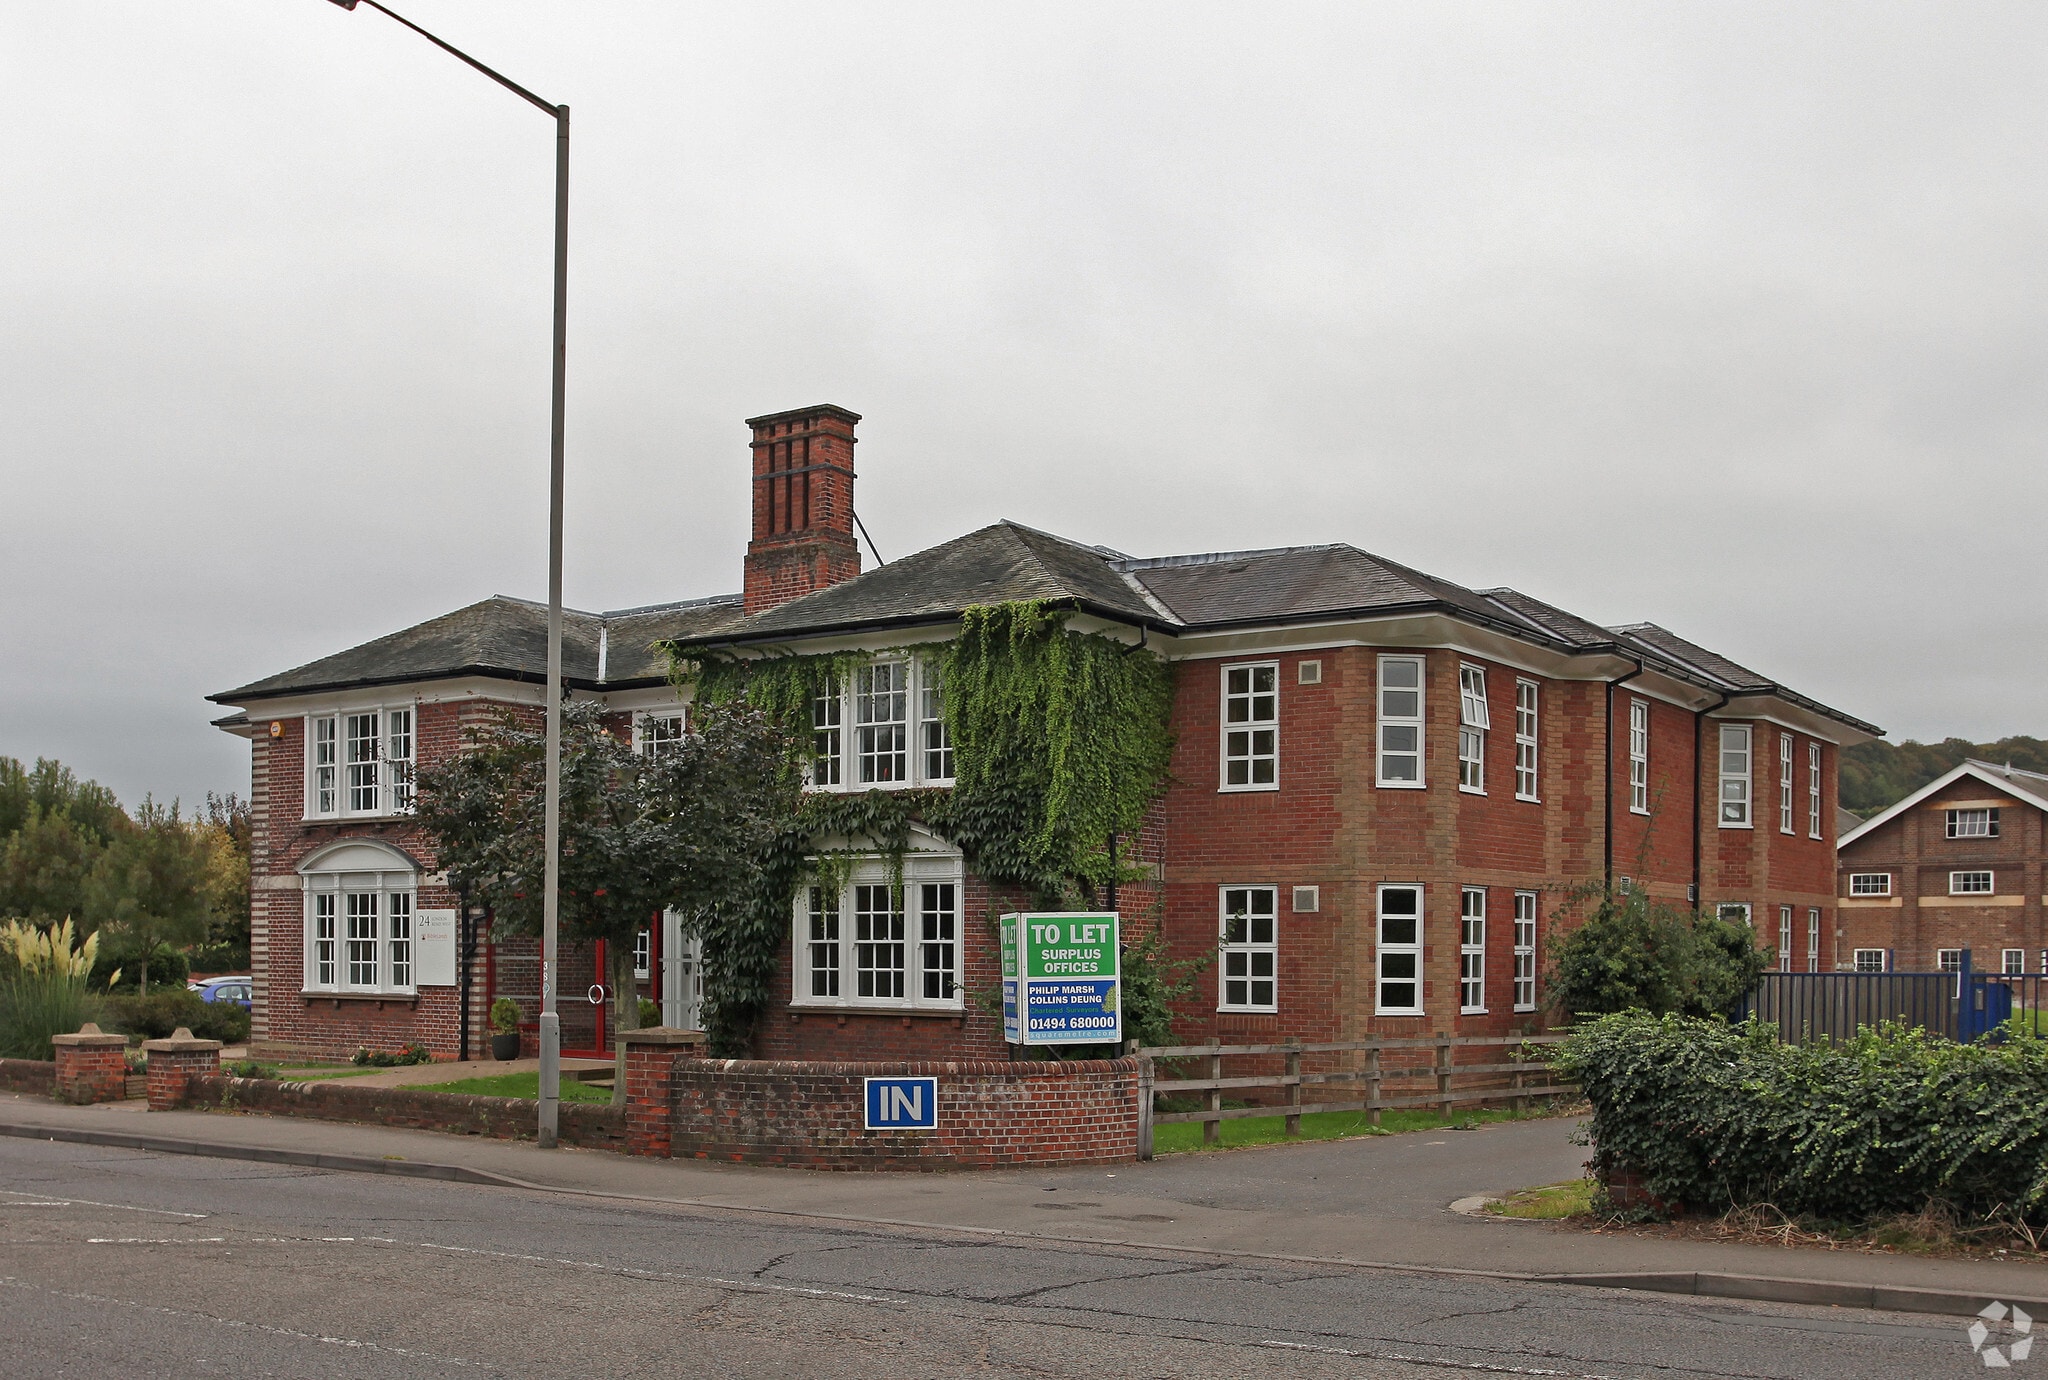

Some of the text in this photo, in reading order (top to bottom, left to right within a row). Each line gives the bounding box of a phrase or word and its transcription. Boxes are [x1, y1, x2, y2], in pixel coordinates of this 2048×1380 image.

[419, 915, 430, 926] 24
[1031, 924, 1110, 944] TO LET
[1041, 949, 1101, 960] SURPLUS
[1044, 962, 1098, 973] OFFICES
[1029, 985, 1095, 995] PHILIP MARSH
[1029, 995, 1102, 1005] COLLINS DEUNG
[1066, 1006, 1099, 1014] Surveyors
[1030, 1017, 1066, 1030] 01494
[1070, 1016, 1115, 1028] 680000
[1030, 1031, 1116, 1039] squaremetre.com
[880, 1086, 922, 1121] IN
